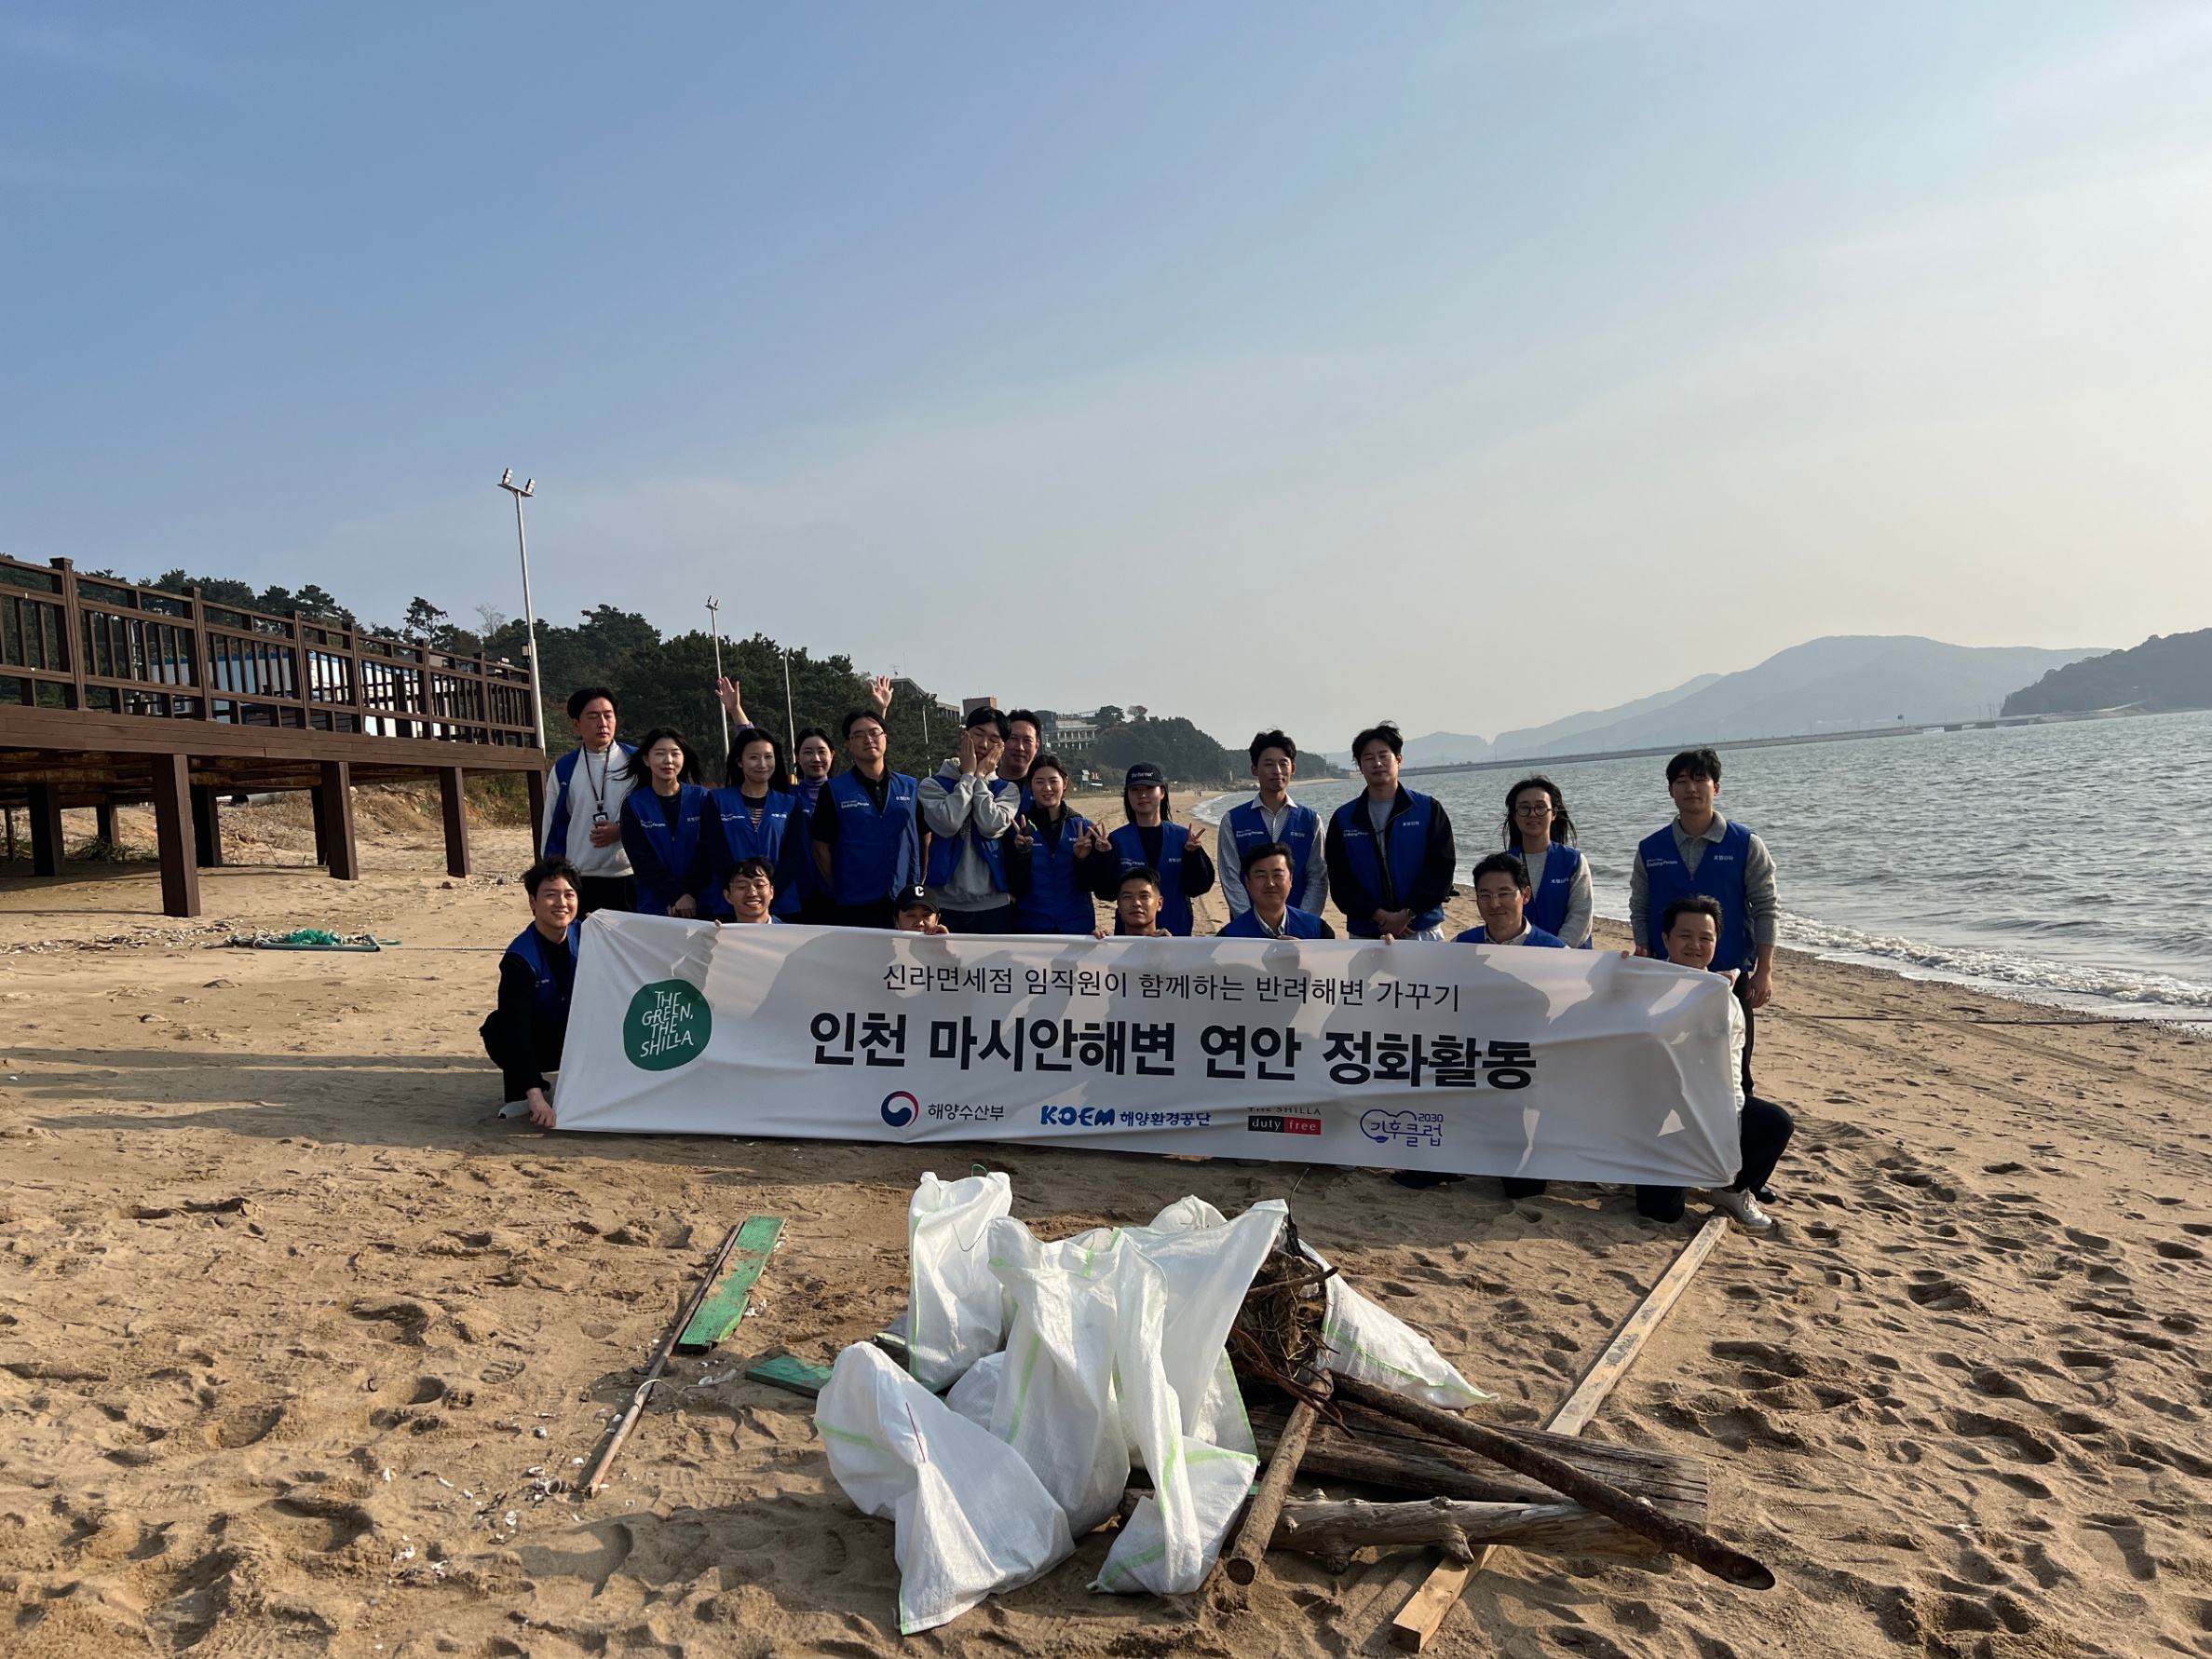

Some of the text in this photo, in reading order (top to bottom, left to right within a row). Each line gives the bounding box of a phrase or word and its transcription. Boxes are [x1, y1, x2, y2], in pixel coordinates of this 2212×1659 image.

[915, 886, 924, 897] C
[883, 965, 1459, 1012] 신라면세점 임직원이 함께하는 반려해변 가꾸기
[655, 991, 682, 1009] THE
[642, 1002, 693, 1026] GREEN,
[650, 1015, 678, 1039] THE
[640, 1030, 694, 1057] SHILLA
[810, 1013, 1537, 1090] 인천 마시안해변 연안 정화활동
[928, 1103, 1005, 1122] 해양수산부
[1040, 1105, 1116, 1127] KOEM
[1120, 1110, 1212, 1127] 해양환경공단
[1276, 1107, 1322, 1115] SHILLA
[1418, 1113, 1444, 1122] 2030
[1252, 1118, 1316, 1131] duty free
[1370, 1120, 1443, 1147] 기후클럽
